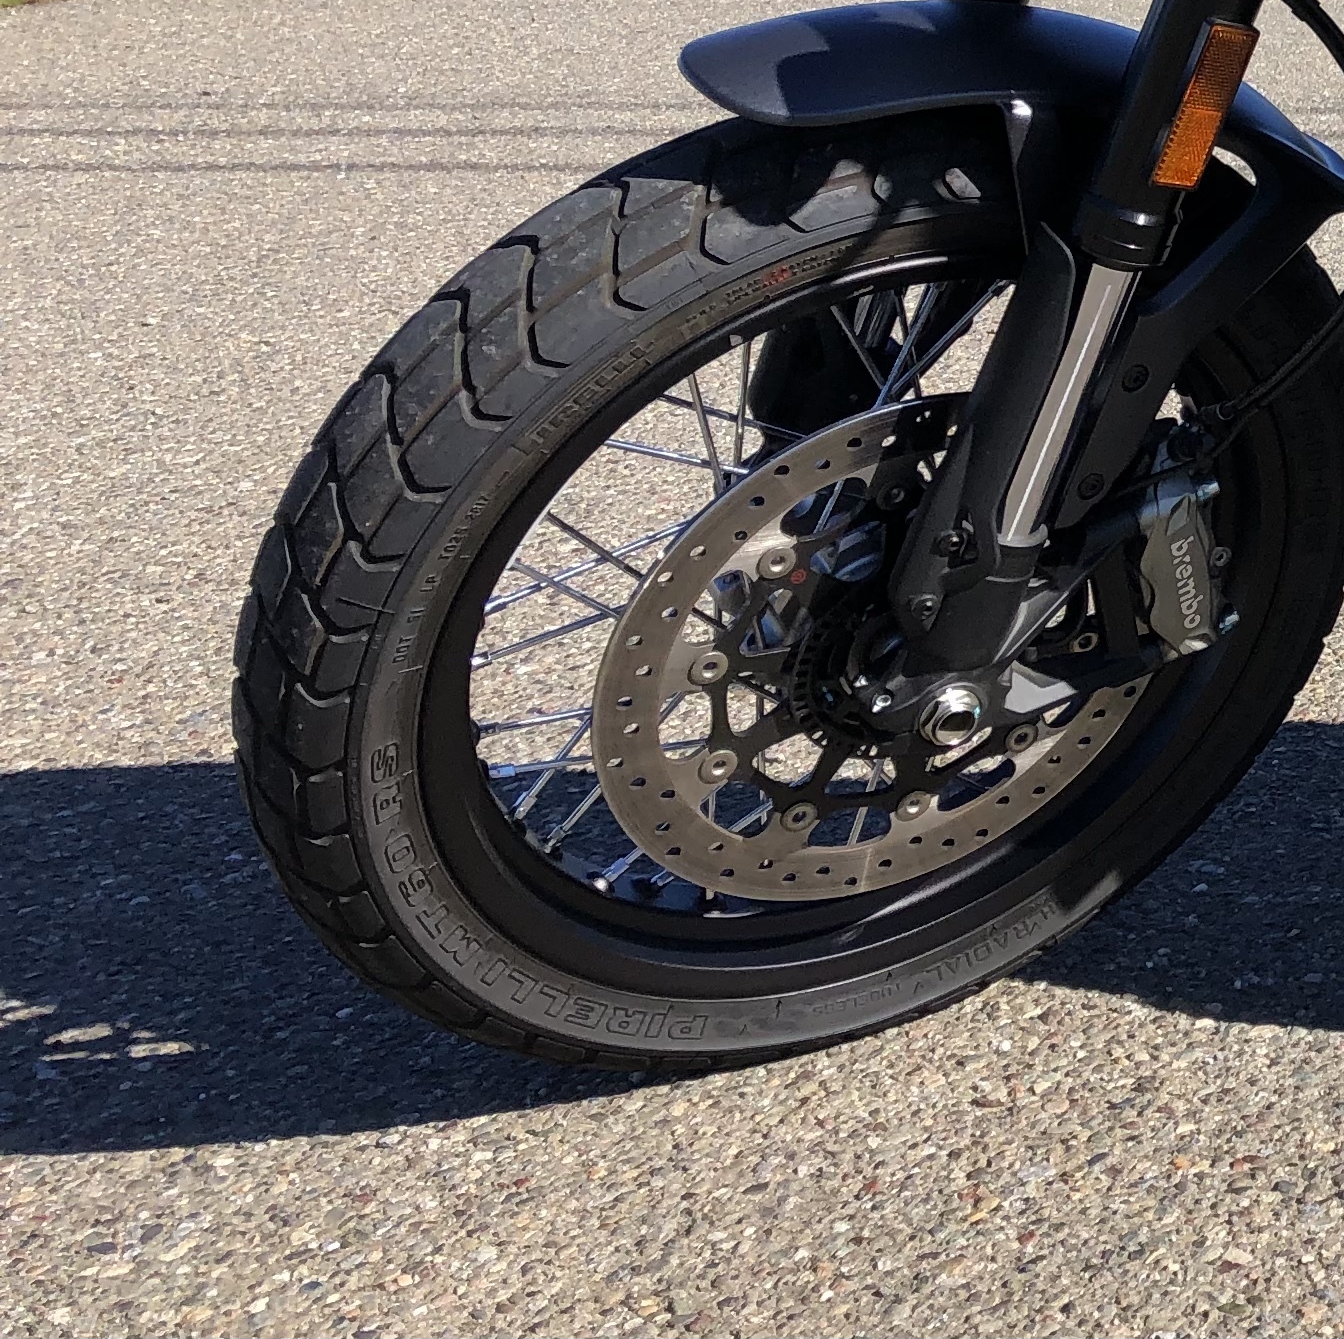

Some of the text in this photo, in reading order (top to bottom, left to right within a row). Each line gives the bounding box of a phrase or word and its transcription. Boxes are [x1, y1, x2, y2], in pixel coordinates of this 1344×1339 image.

[1170, 535, 1204, 629] brembo
[370, 742, 709, 1041] PIRELLI MT60 RS
[924, 920, 1030, 982] RADIAL
